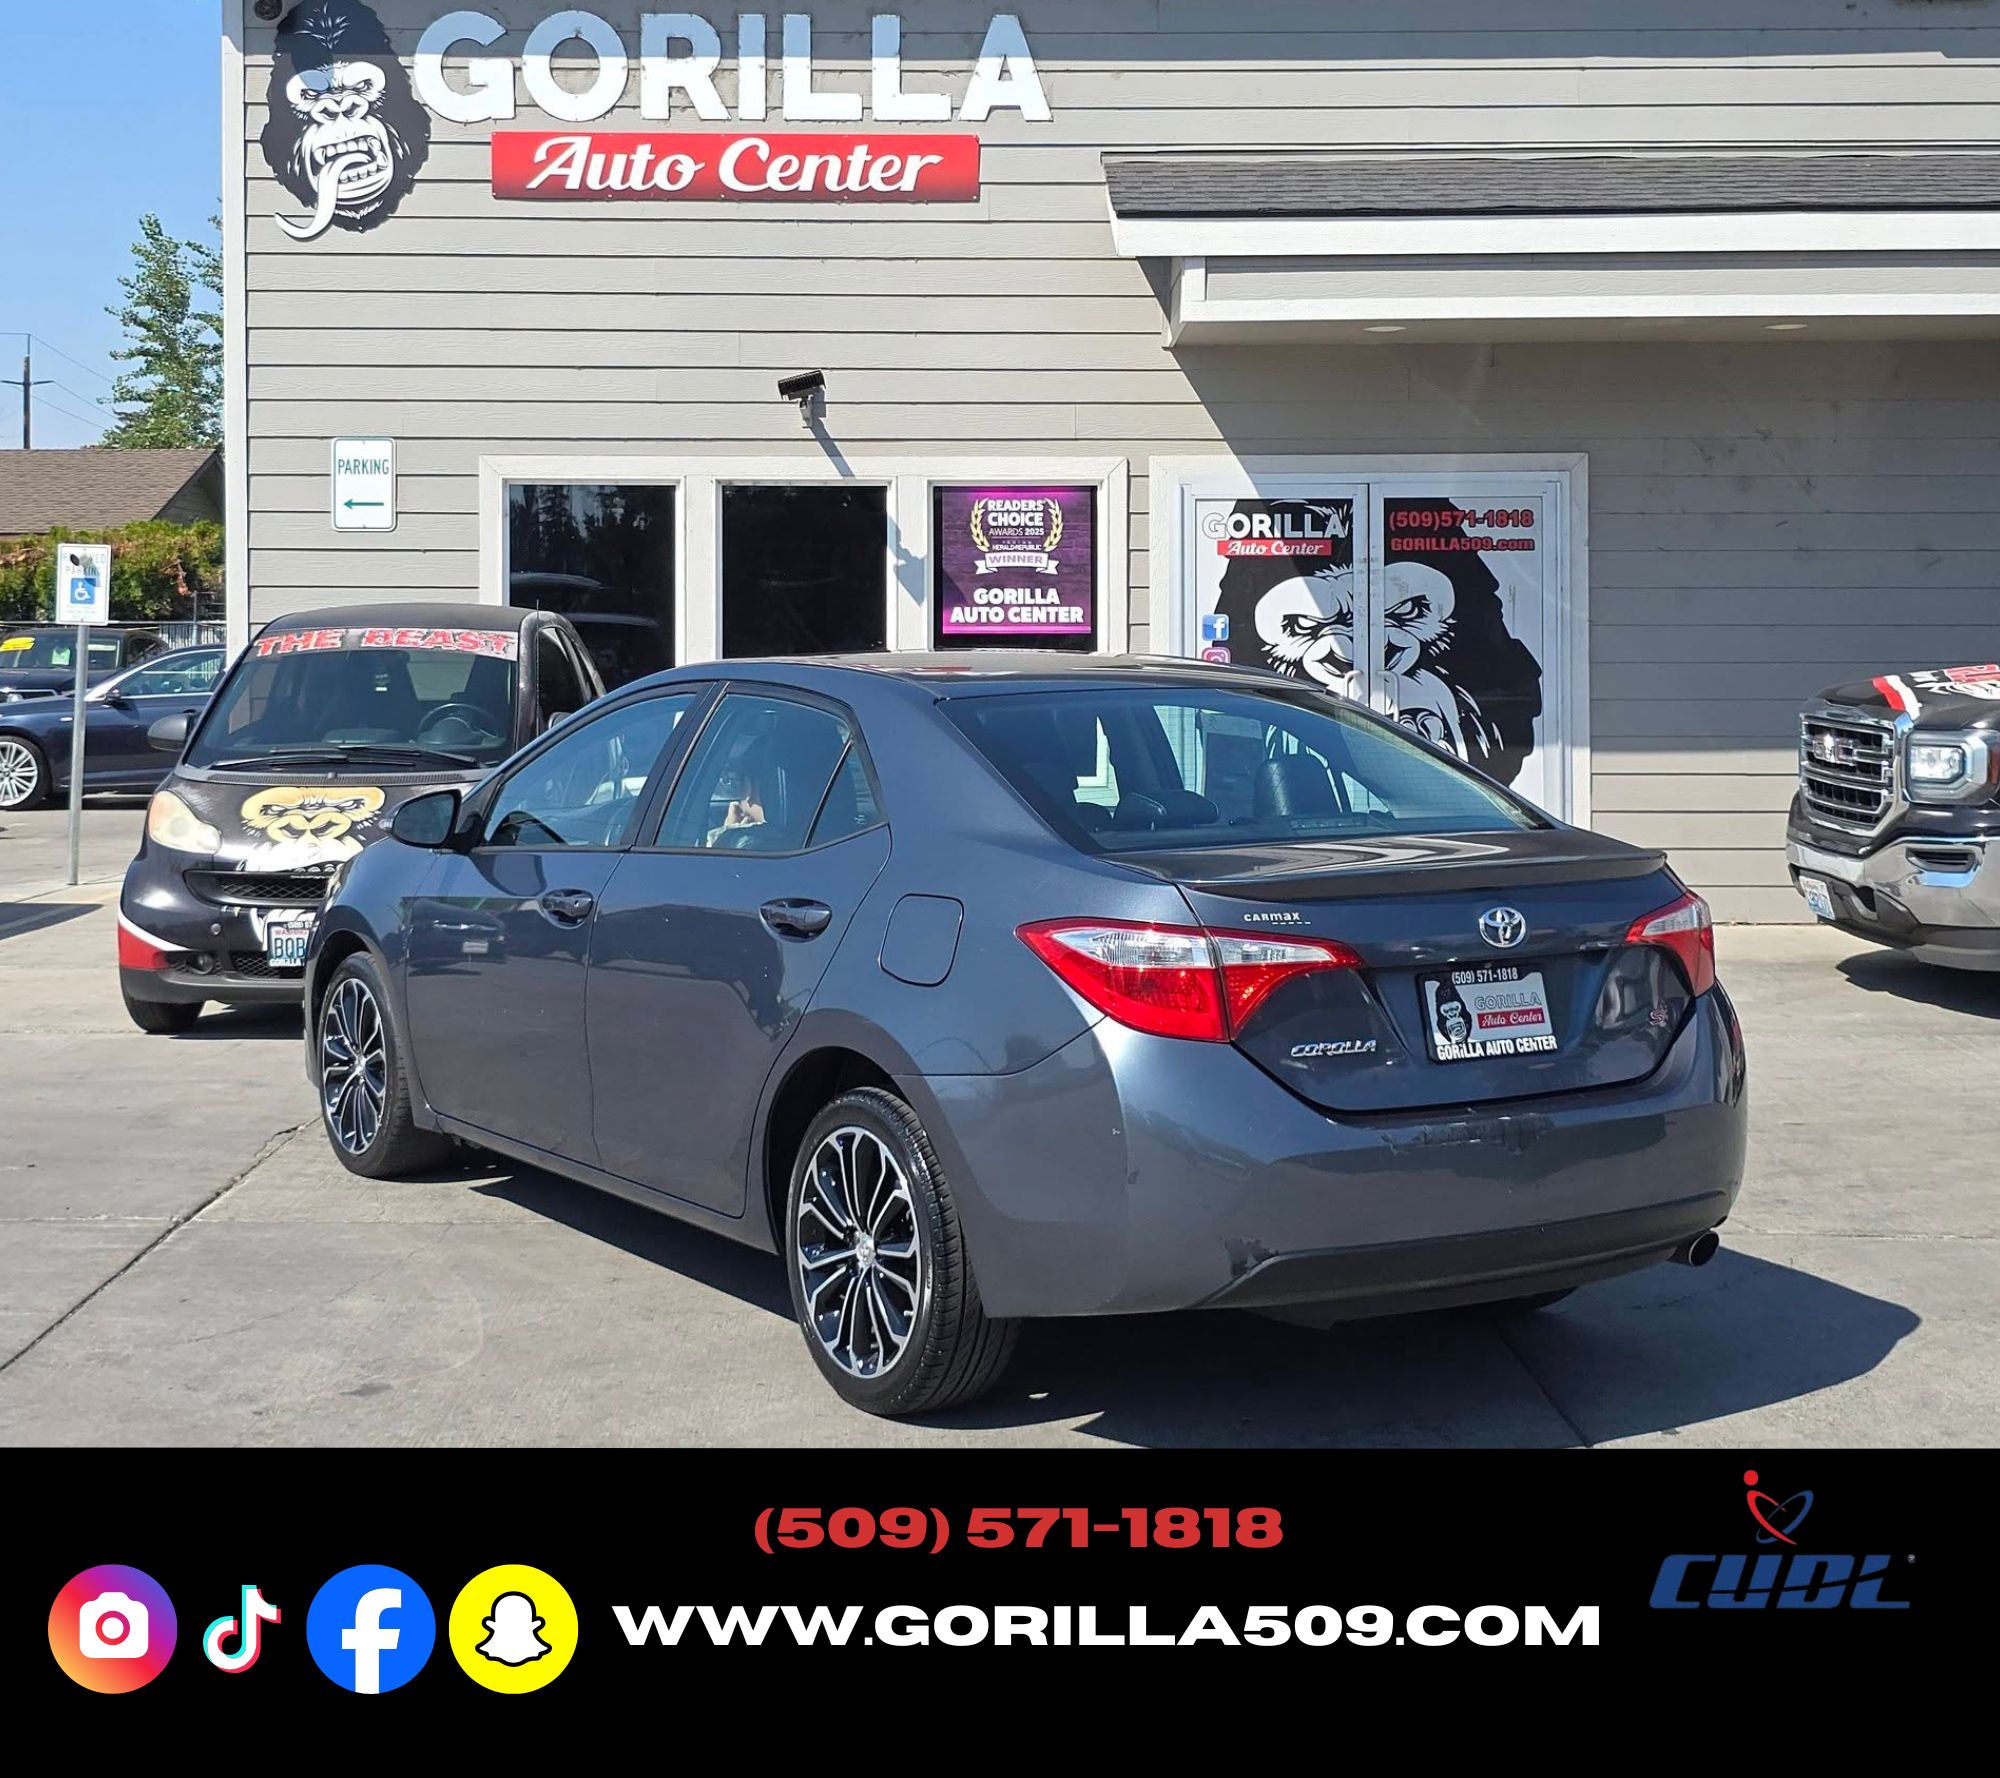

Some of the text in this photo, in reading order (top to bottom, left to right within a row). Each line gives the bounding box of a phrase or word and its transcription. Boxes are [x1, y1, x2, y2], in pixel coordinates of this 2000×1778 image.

[412, 9, 1054, 123] GORILLA
[526, 135, 944, 193] Auto Center
[338, 458, 390, 475] PARKING
[987, 512, 1044, 527] CHOICE
[1202, 512, 1346, 540] GORILLA
[1388, 509, 1535, 532] (509)571-1818
[988, 527, 1044, 536] AWARDS 2025
[1227, 540, 1324, 556] Auto Center
[1390, 536, 1535, 551] GORILLA509.com
[988, 554, 1043, 564] WINNER
[973, 588, 1060, 605] GORILLA
[950, 606, 1084, 623] AUTO CENTER
[255, 628, 517, 657] THE BEAST
[1451, 967, 1519, 984] (509) 571-1818
[1475, 991, 1541, 1010] GORILLA
[1481, 1011, 1543, 1027] Auto Center
[1291, 1039, 1377, 1058] COROLLA
[1486, 1040, 1515, 1056] AUTO
[1516, 1035, 1558, 1053] CENTER
